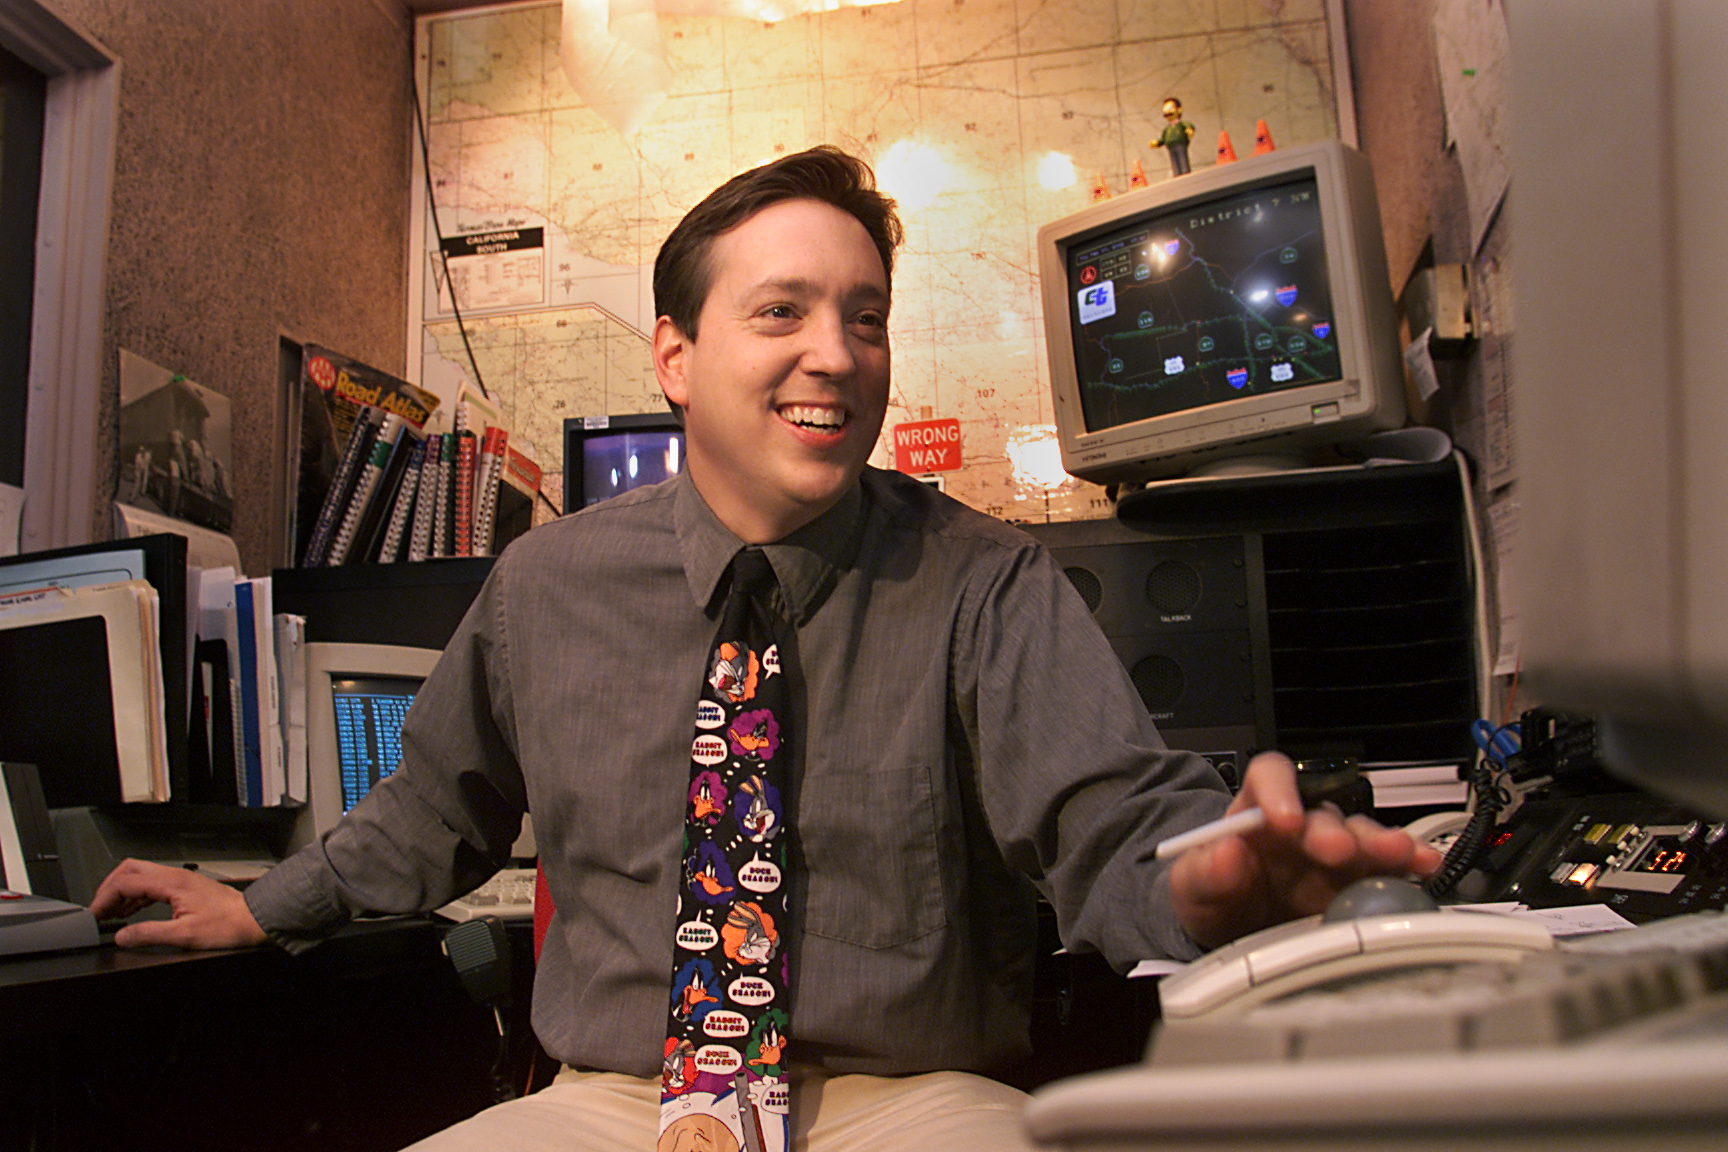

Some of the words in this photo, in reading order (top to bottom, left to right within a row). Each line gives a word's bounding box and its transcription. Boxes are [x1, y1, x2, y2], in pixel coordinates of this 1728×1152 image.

[466, 231, 519, 245] CALIFORNIA
[476, 243, 508, 254] SOUTH
[335, 369, 382, 405] Road
[380, 391, 426, 423] Atlas
[977, 388, 995, 398] 107
[896, 425, 959, 446] WRONG
[909, 448, 948, 467] WAY
[1160, 614, 1192, 622] TALKBACK
[699, 706, 719, 714] ABBIT
[695, 741, 722, 749] RABBIT
[750, 867, 771, 875] DUCK
[740, 981, 764, 990] DUCK
[709, 1015, 742, 1025] RABBIT
[705, 1050, 730, 1059] DUCK
